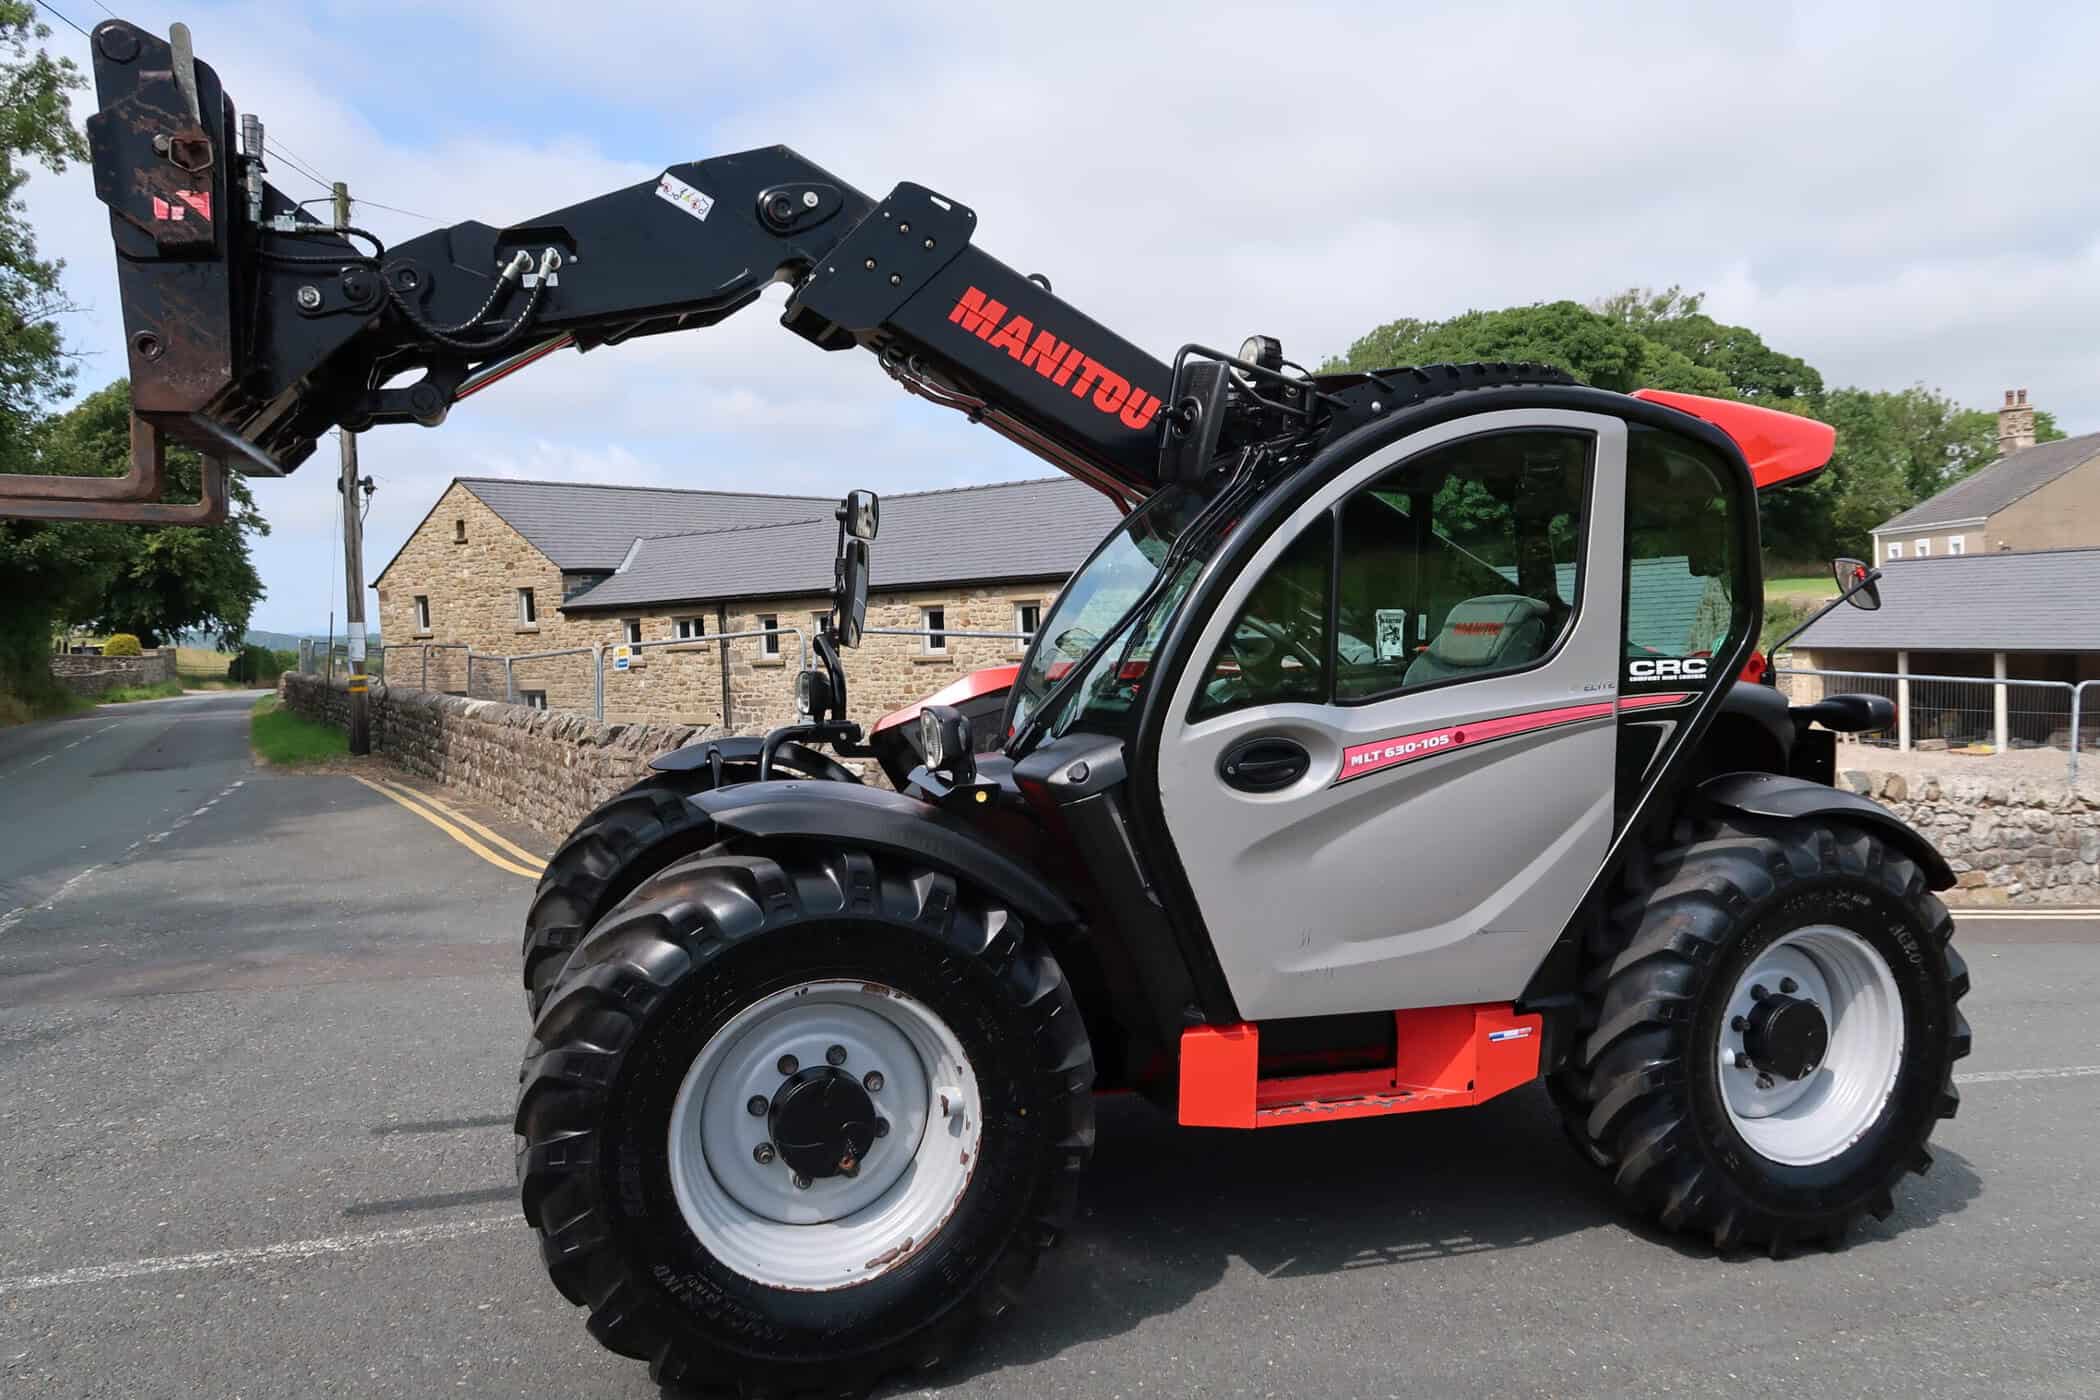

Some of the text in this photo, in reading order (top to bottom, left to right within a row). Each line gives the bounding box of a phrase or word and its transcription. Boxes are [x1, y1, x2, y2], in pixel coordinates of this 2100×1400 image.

[948, 285, 1162, 431] MANITOU
[1629, 658, 1708, 677] CRC
[1350, 734, 1451, 766] MLT 630-105
